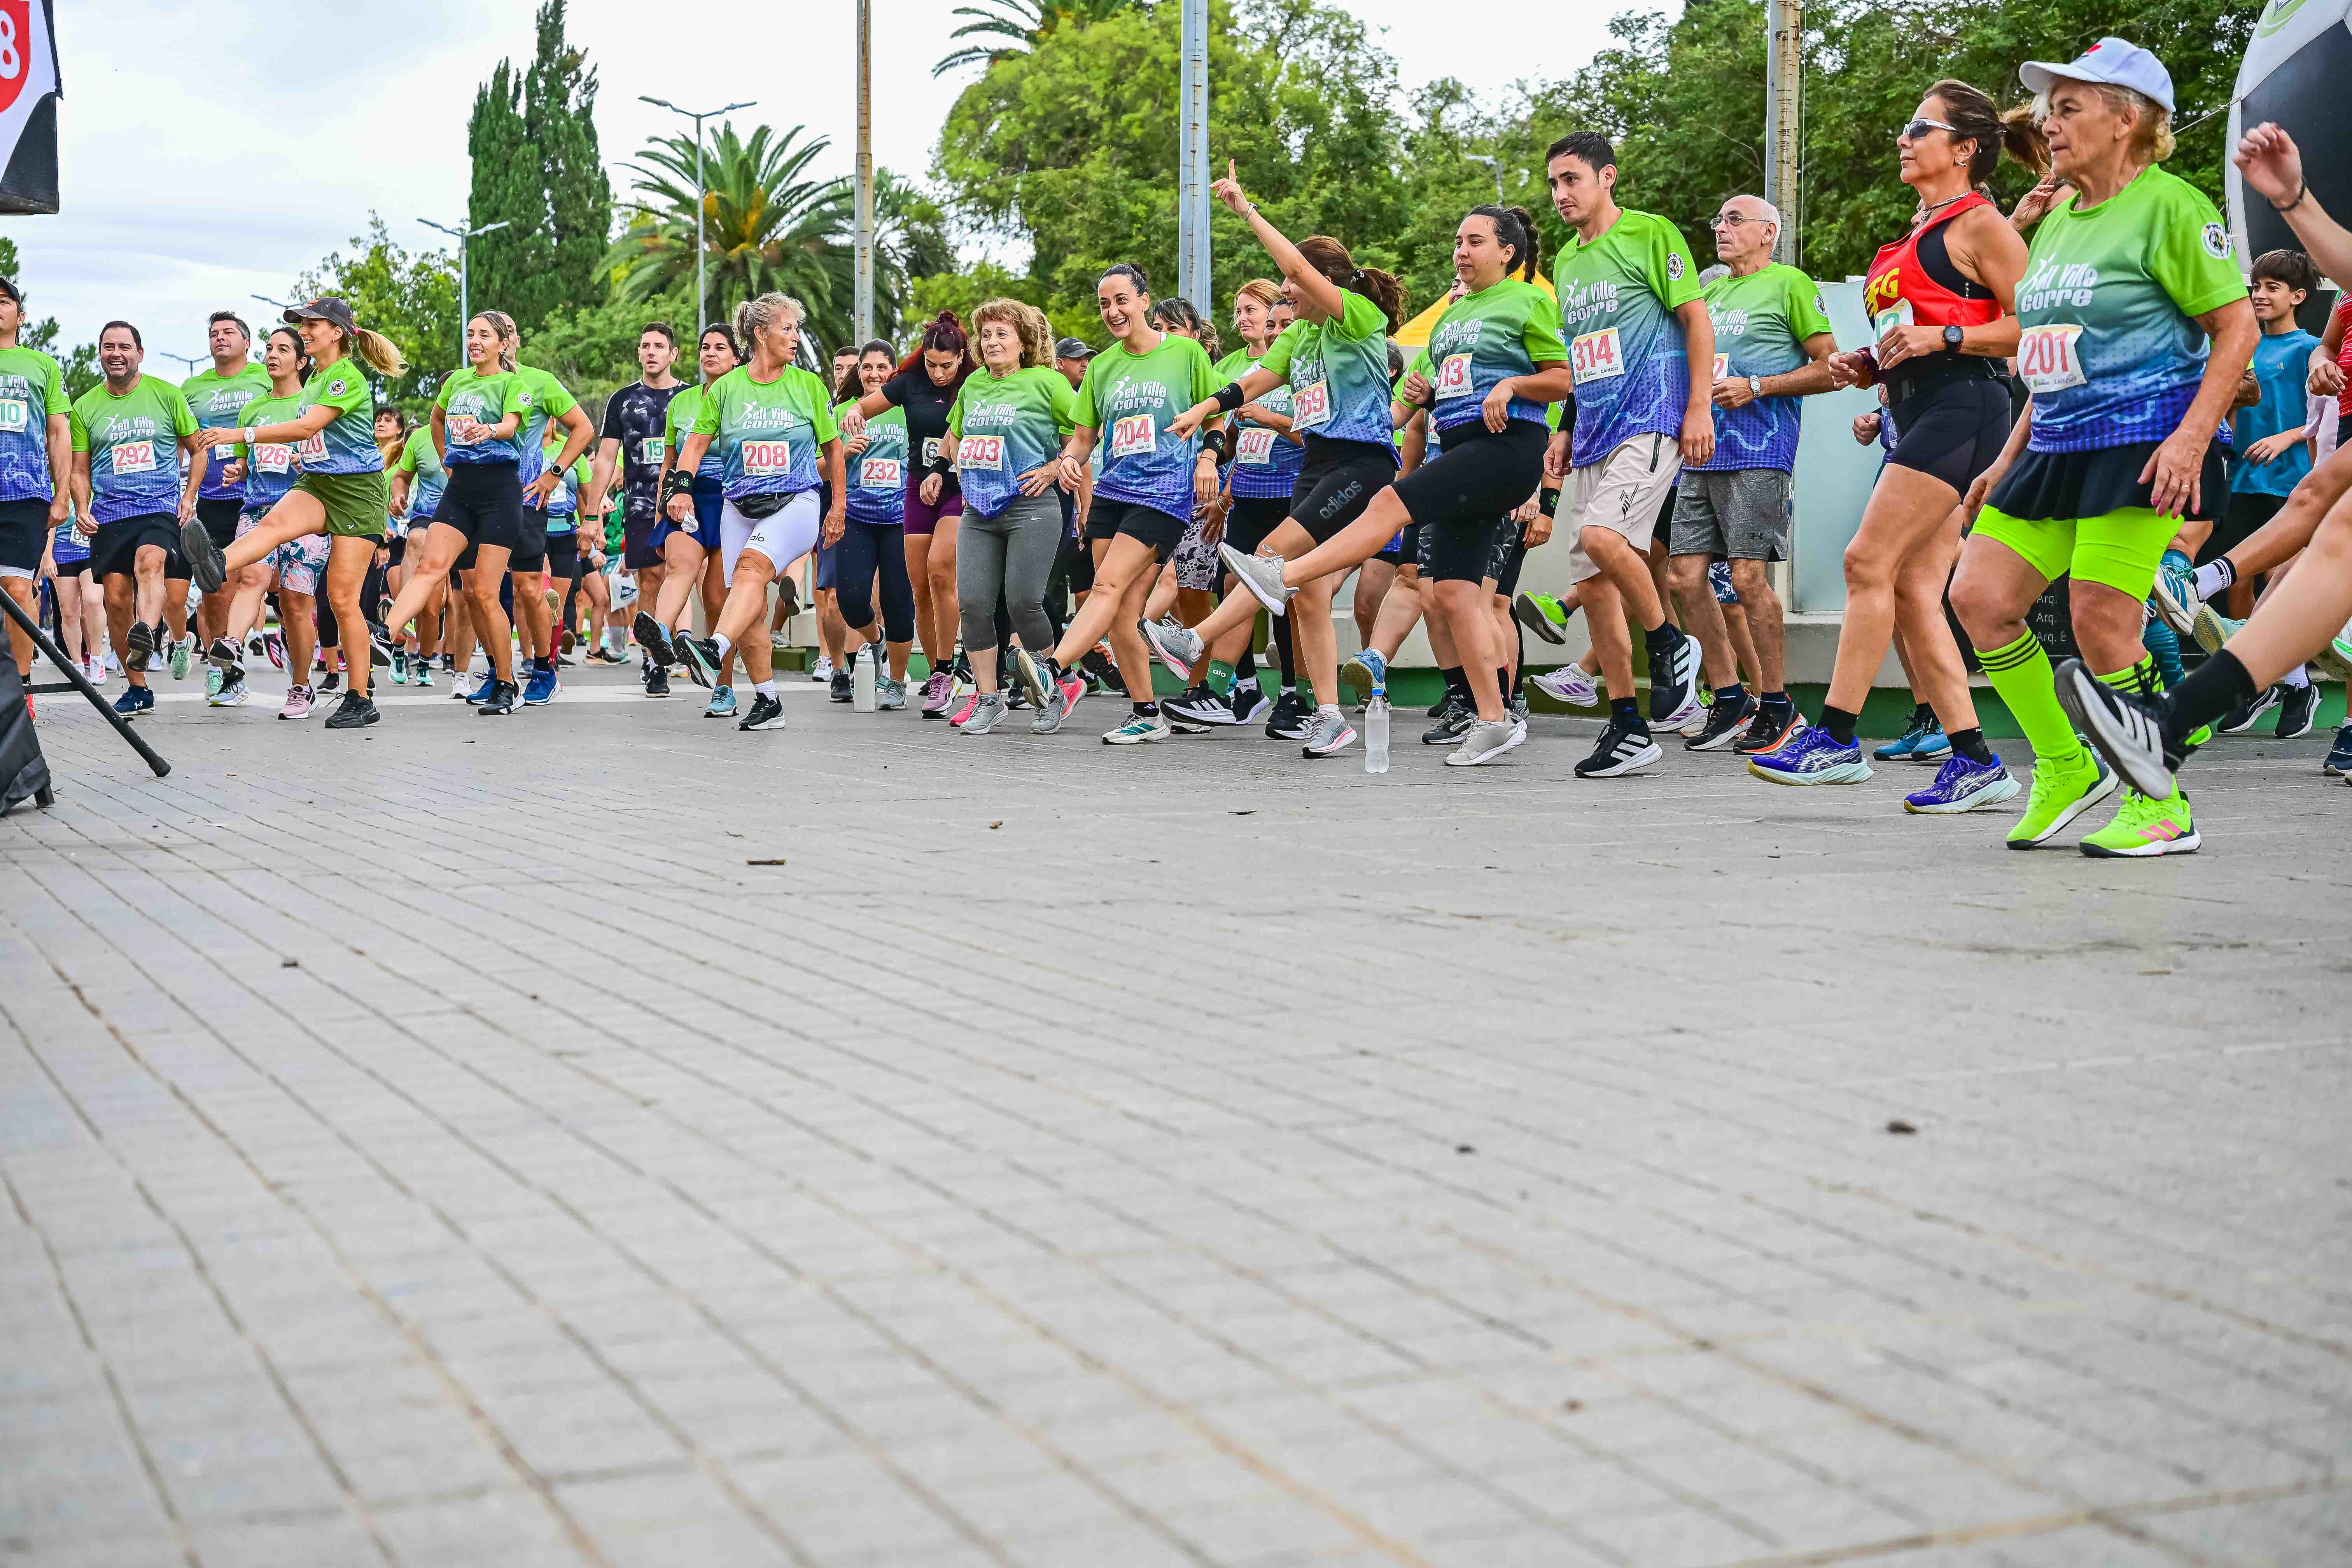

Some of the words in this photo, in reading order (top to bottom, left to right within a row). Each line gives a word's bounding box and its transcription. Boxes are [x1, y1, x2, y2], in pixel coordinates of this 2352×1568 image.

[1591, 280, 1617, 302] Ville
[2021, 289, 2093, 313] corre
[1568, 299, 1618, 324] corre
[1727, 309, 1748, 324] Ville
[1713, 324, 1745, 336] orre
[1574, 334, 1614, 371] 314
[2024, 331, 2068, 376] 201
[0, 388, 29, 398] rre
[1142, 381, 1167, 397] Ville
[994, 404, 1017, 417] Ville
[1114, 397, 1165, 411] corre
[1296, 386, 1324, 422] 269
[133, 416, 154, 428] Ville
[771, 408, 794, 422] Ville
[967, 416, 1015, 427] corre
[742, 420, 794, 430] corre
[884, 424, 905, 436] Ville
[109, 428, 155, 441] corre
[871, 435, 904, 443] orre
[1115, 418, 1151, 448] 204
[1239, 432, 1272, 454] 301
[114, 445, 152, 467] 292
[256, 445, 287, 466] 326
[745, 445, 786, 467] 208
[961, 439, 999, 462] 303
[864, 462, 897, 480] 232
[1320, 481, 1363, 519] adidas
[750, 532, 765, 542] alo
[2037, 594, 2057, 607] Arq.
[2036, 612, 2057, 625] Arq.
[2037, 631, 2056, 644] Arq.
[1213, 669, 1226, 677] alo
